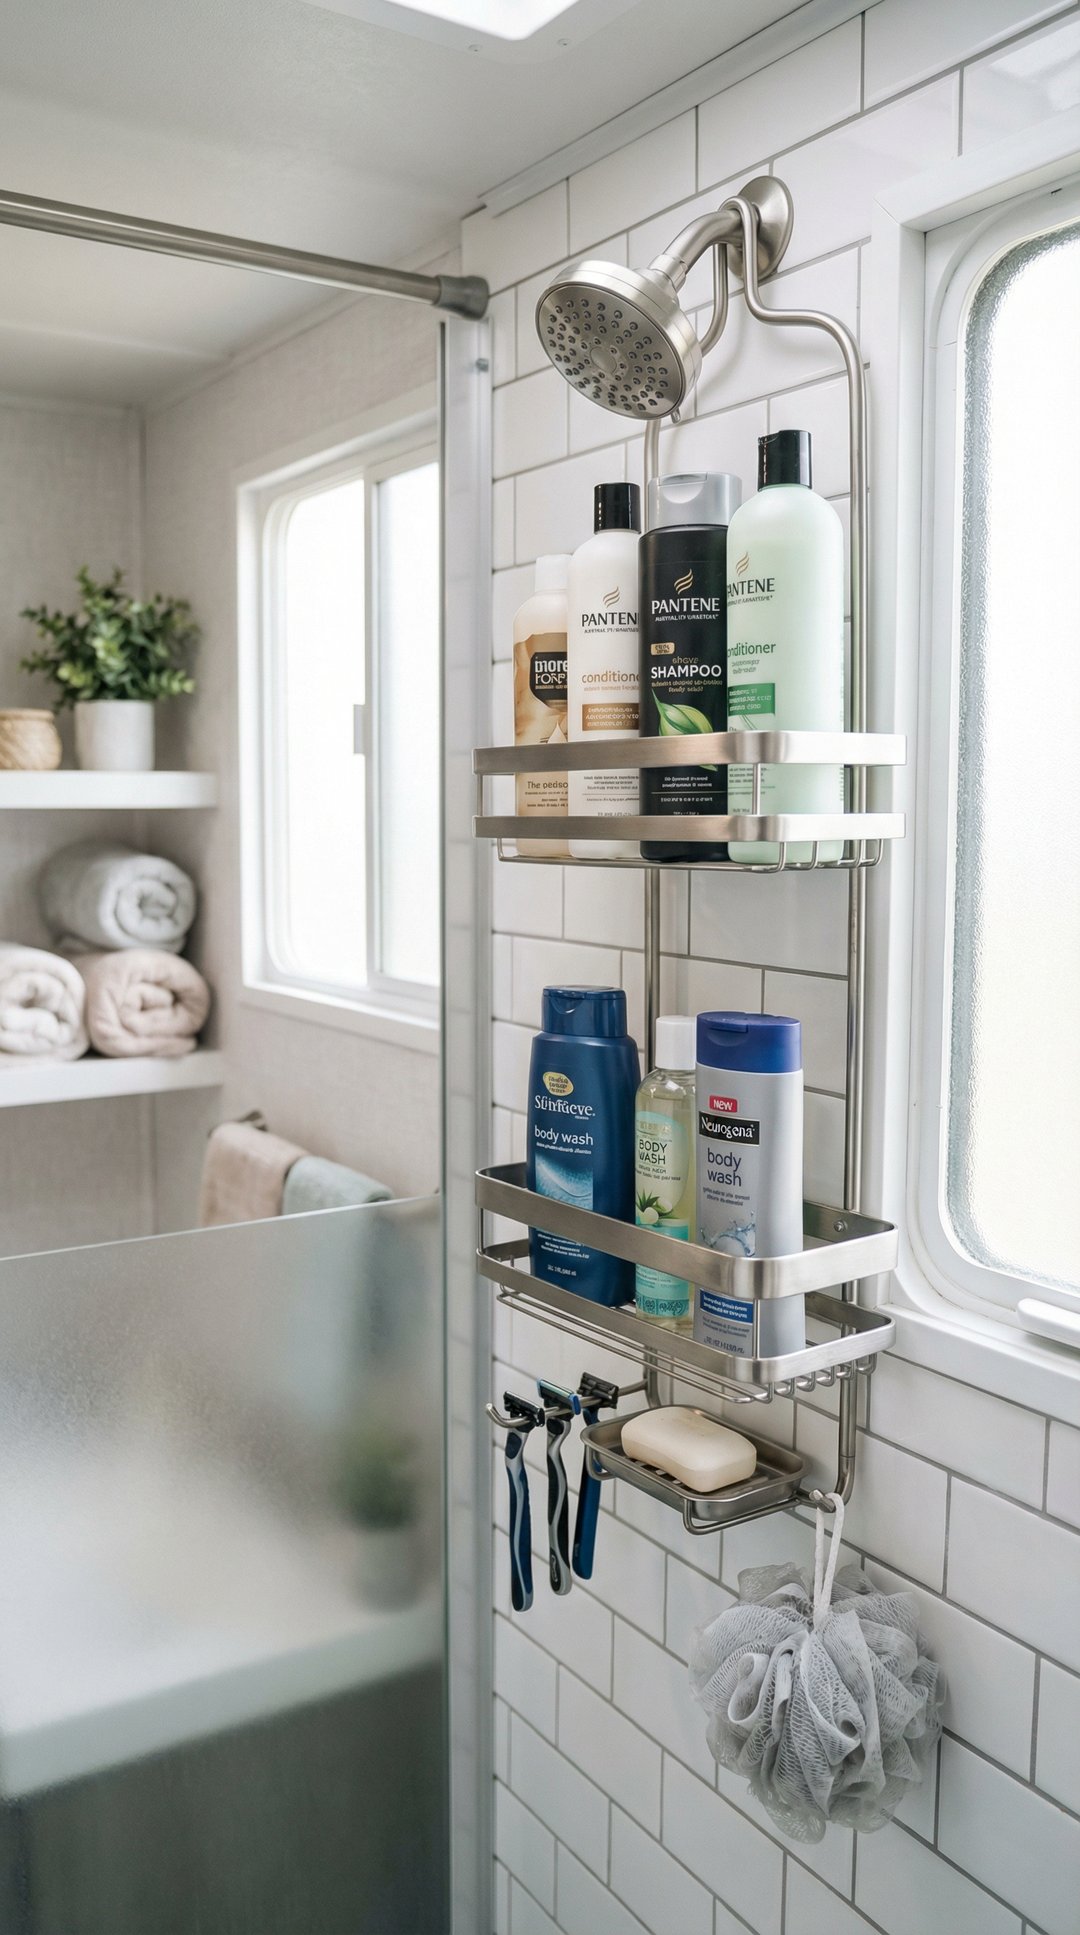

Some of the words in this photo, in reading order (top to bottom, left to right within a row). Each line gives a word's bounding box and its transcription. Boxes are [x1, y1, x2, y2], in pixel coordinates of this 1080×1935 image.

[727, 577, 775, 597] ANTENE
[651, 597, 720, 614] PANTENE
[581, 612, 639, 627] PANTEN
[727, 642, 777, 658] onditioner
[581, 669, 640, 684] condition
[651, 664, 722, 679] SHAMPOO
[527, 781, 541, 789] The
[534, 1124, 560, 1145] body
[561, 1132, 594, 1146] wash
[639, 1139, 668, 1153] BODY
[639, 1152, 666, 1165] WASH
[707, 1147, 741, 1172] body
[707, 1169, 741, 1187] wash
